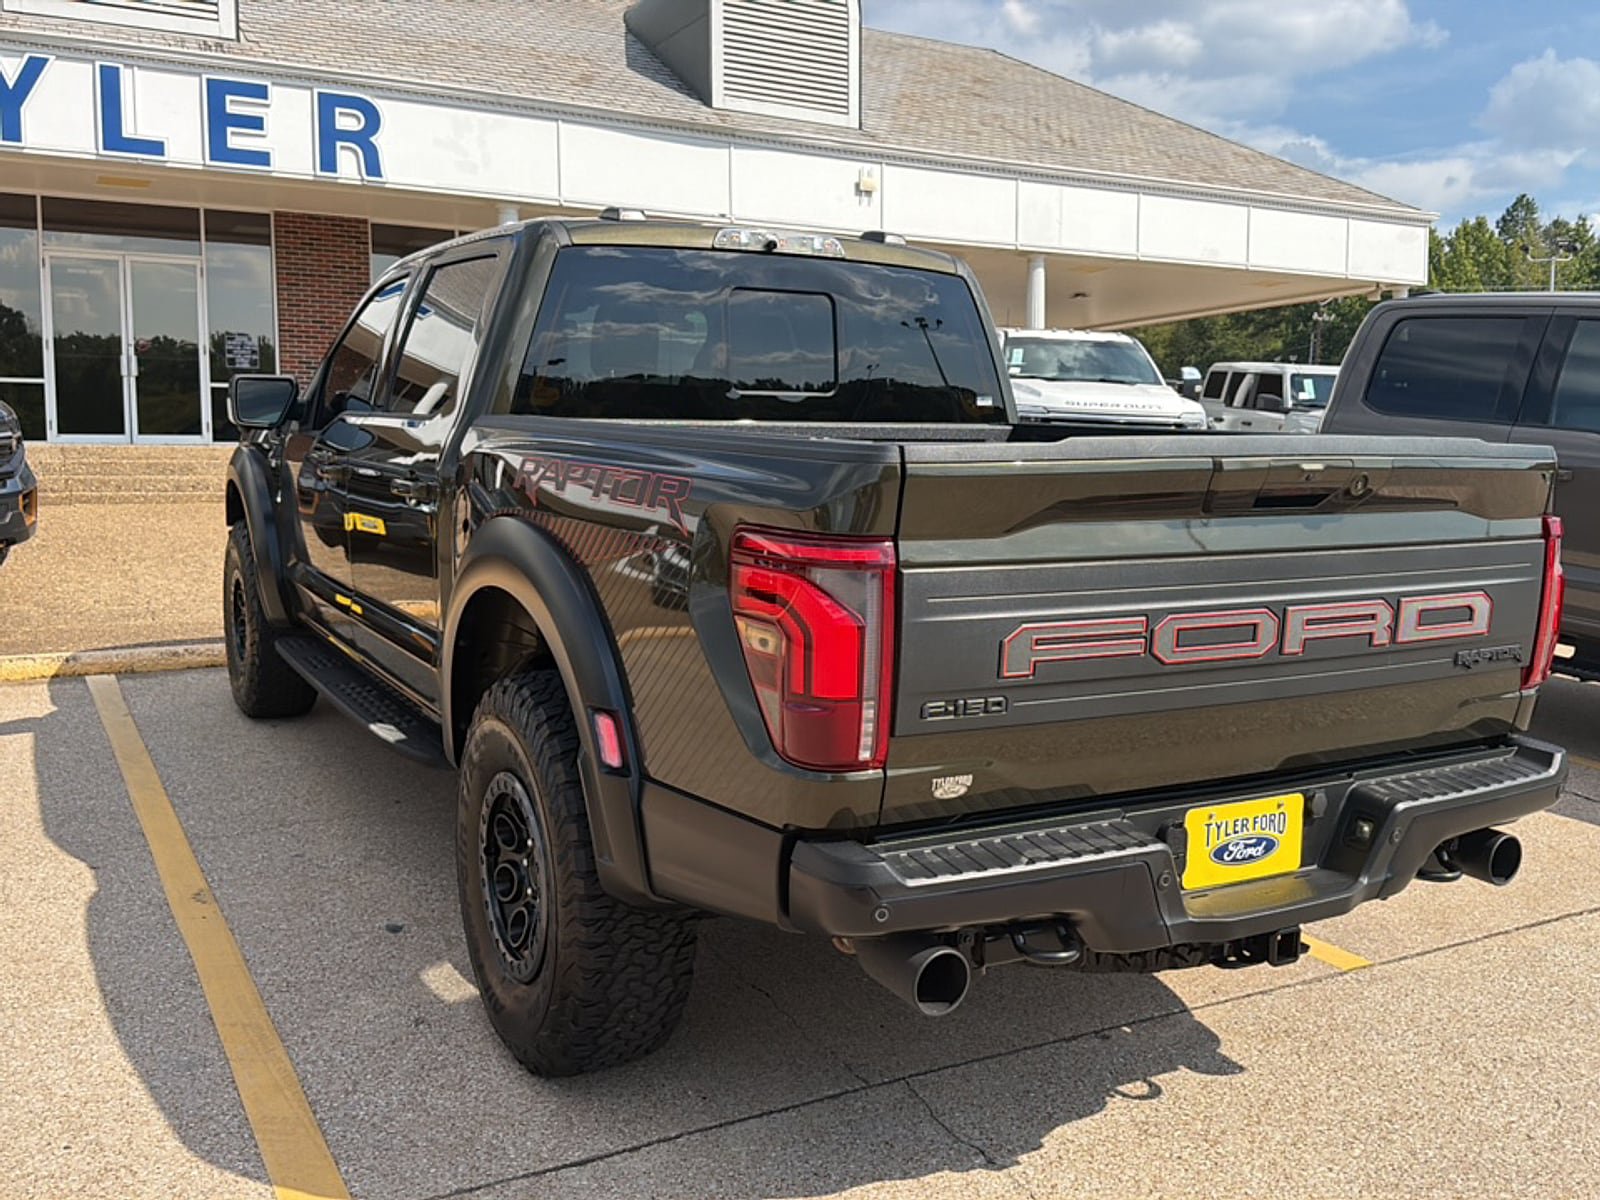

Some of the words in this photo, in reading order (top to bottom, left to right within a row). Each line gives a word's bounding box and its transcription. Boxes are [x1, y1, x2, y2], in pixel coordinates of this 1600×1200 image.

[513, 457, 692, 537] RAPTOR
[999, 590, 1494, 680] FORD
[920, 696, 1008, 720] F-150
[1205, 818, 1249, 847] TYLER
[1253, 812, 1286, 835] FORD
[1223, 839, 1266, 862] Ford
